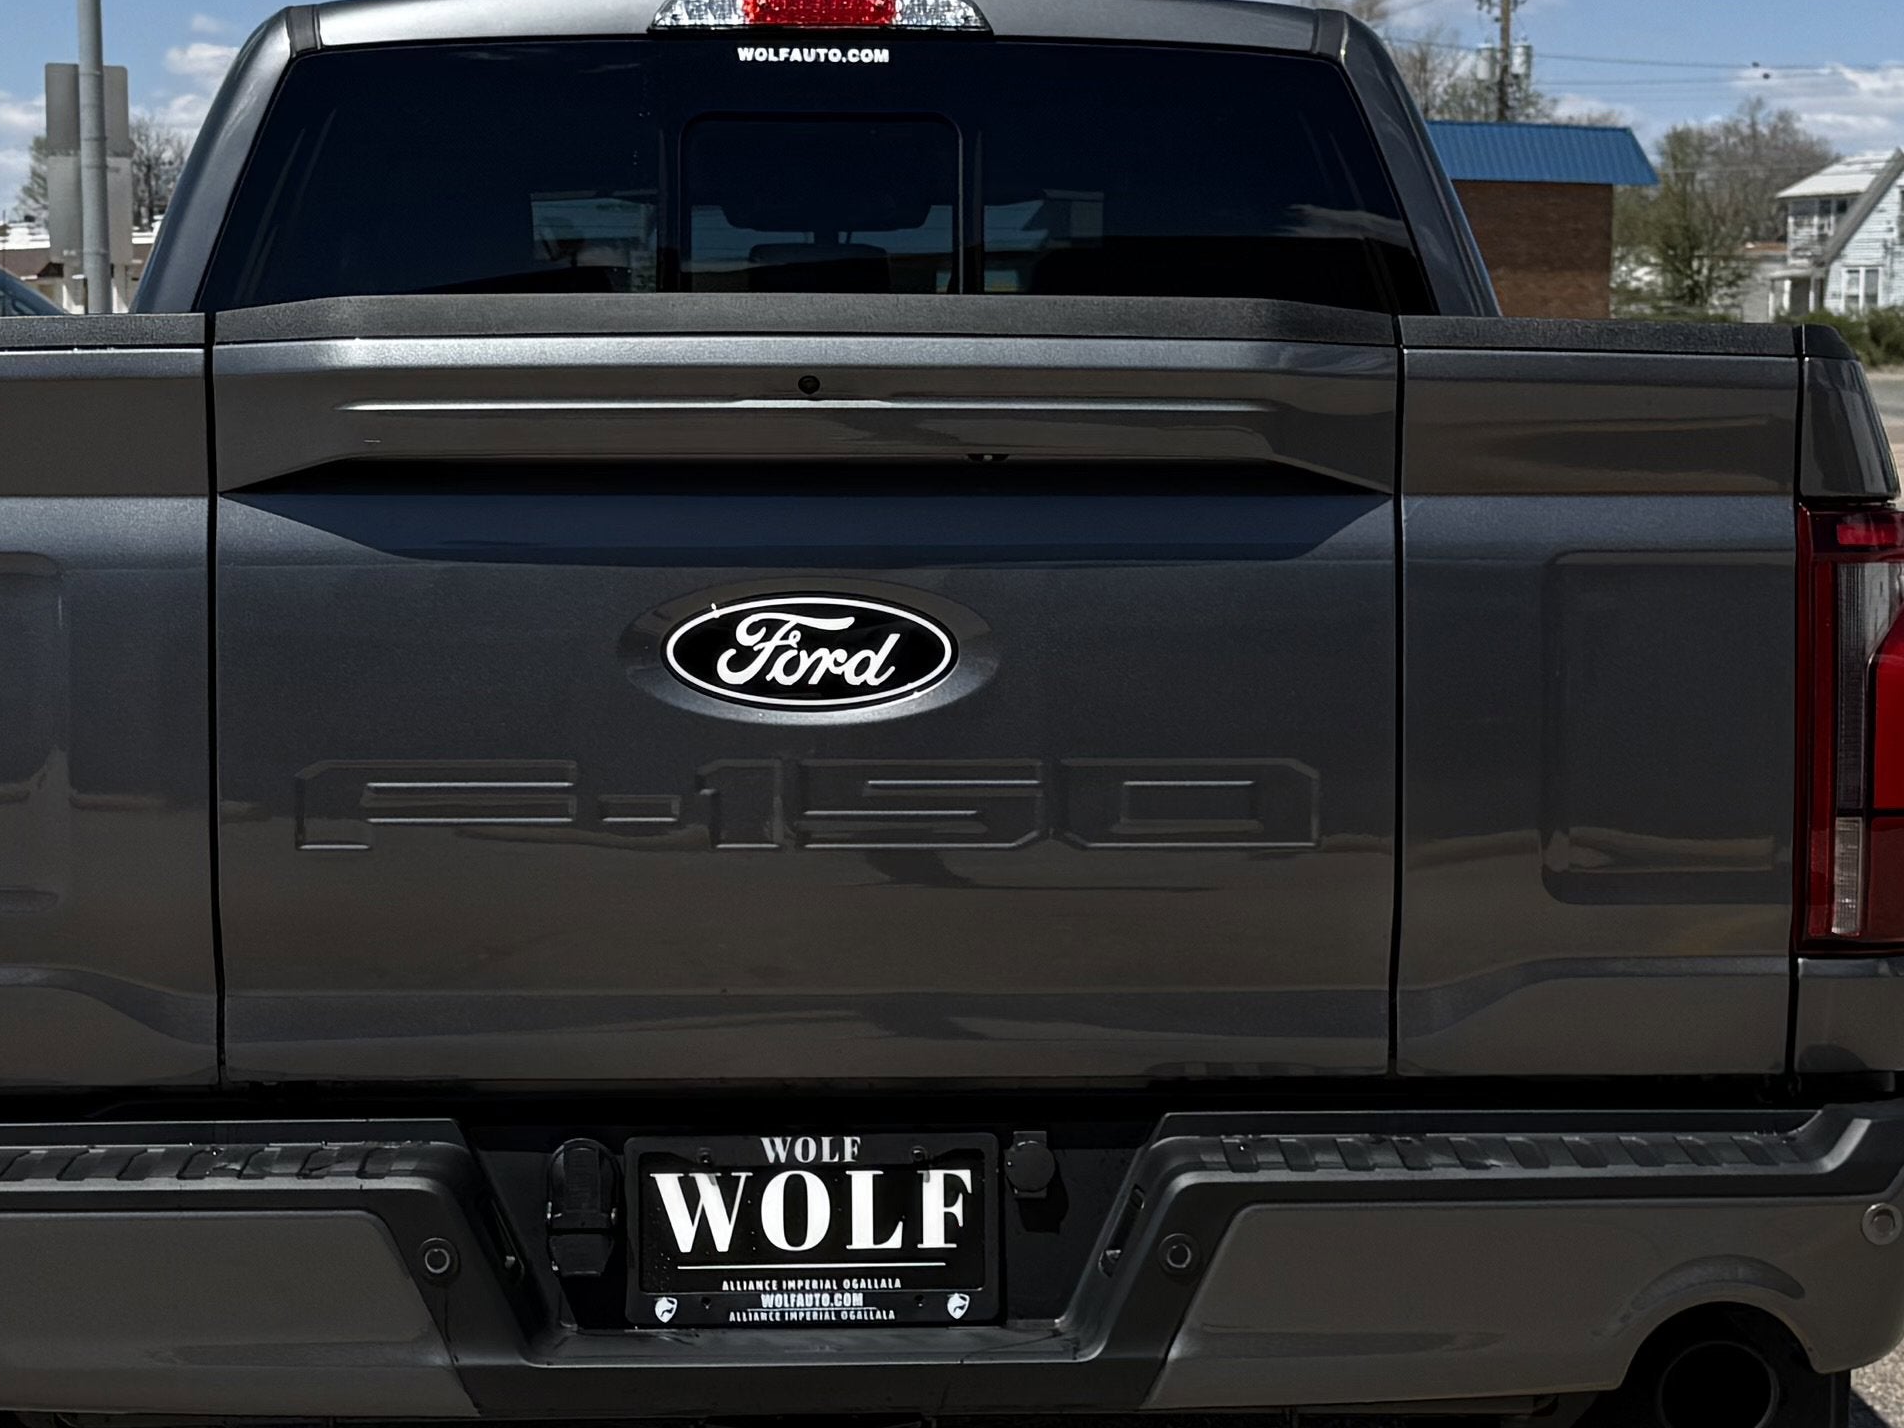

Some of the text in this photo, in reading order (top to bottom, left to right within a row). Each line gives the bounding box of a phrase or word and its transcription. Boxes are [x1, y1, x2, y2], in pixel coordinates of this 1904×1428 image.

[737, 47, 890, 63] WOLFAUTO.COM
[716, 612, 900, 686] Ford
[294, 756, 1322, 852] F-150
[760, 1136, 862, 1164] WOLF
[649, 1169, 973, 1254] WOLF
[721, 1278, 902, 1291] ALLIANCE IMPERIAL OGALLALA
[760, 1292, 864, 1308] WOLFAUTO.COM
[728, 1310, 896, 1322] ALLIANCE IMPERIAL OGALLALA
